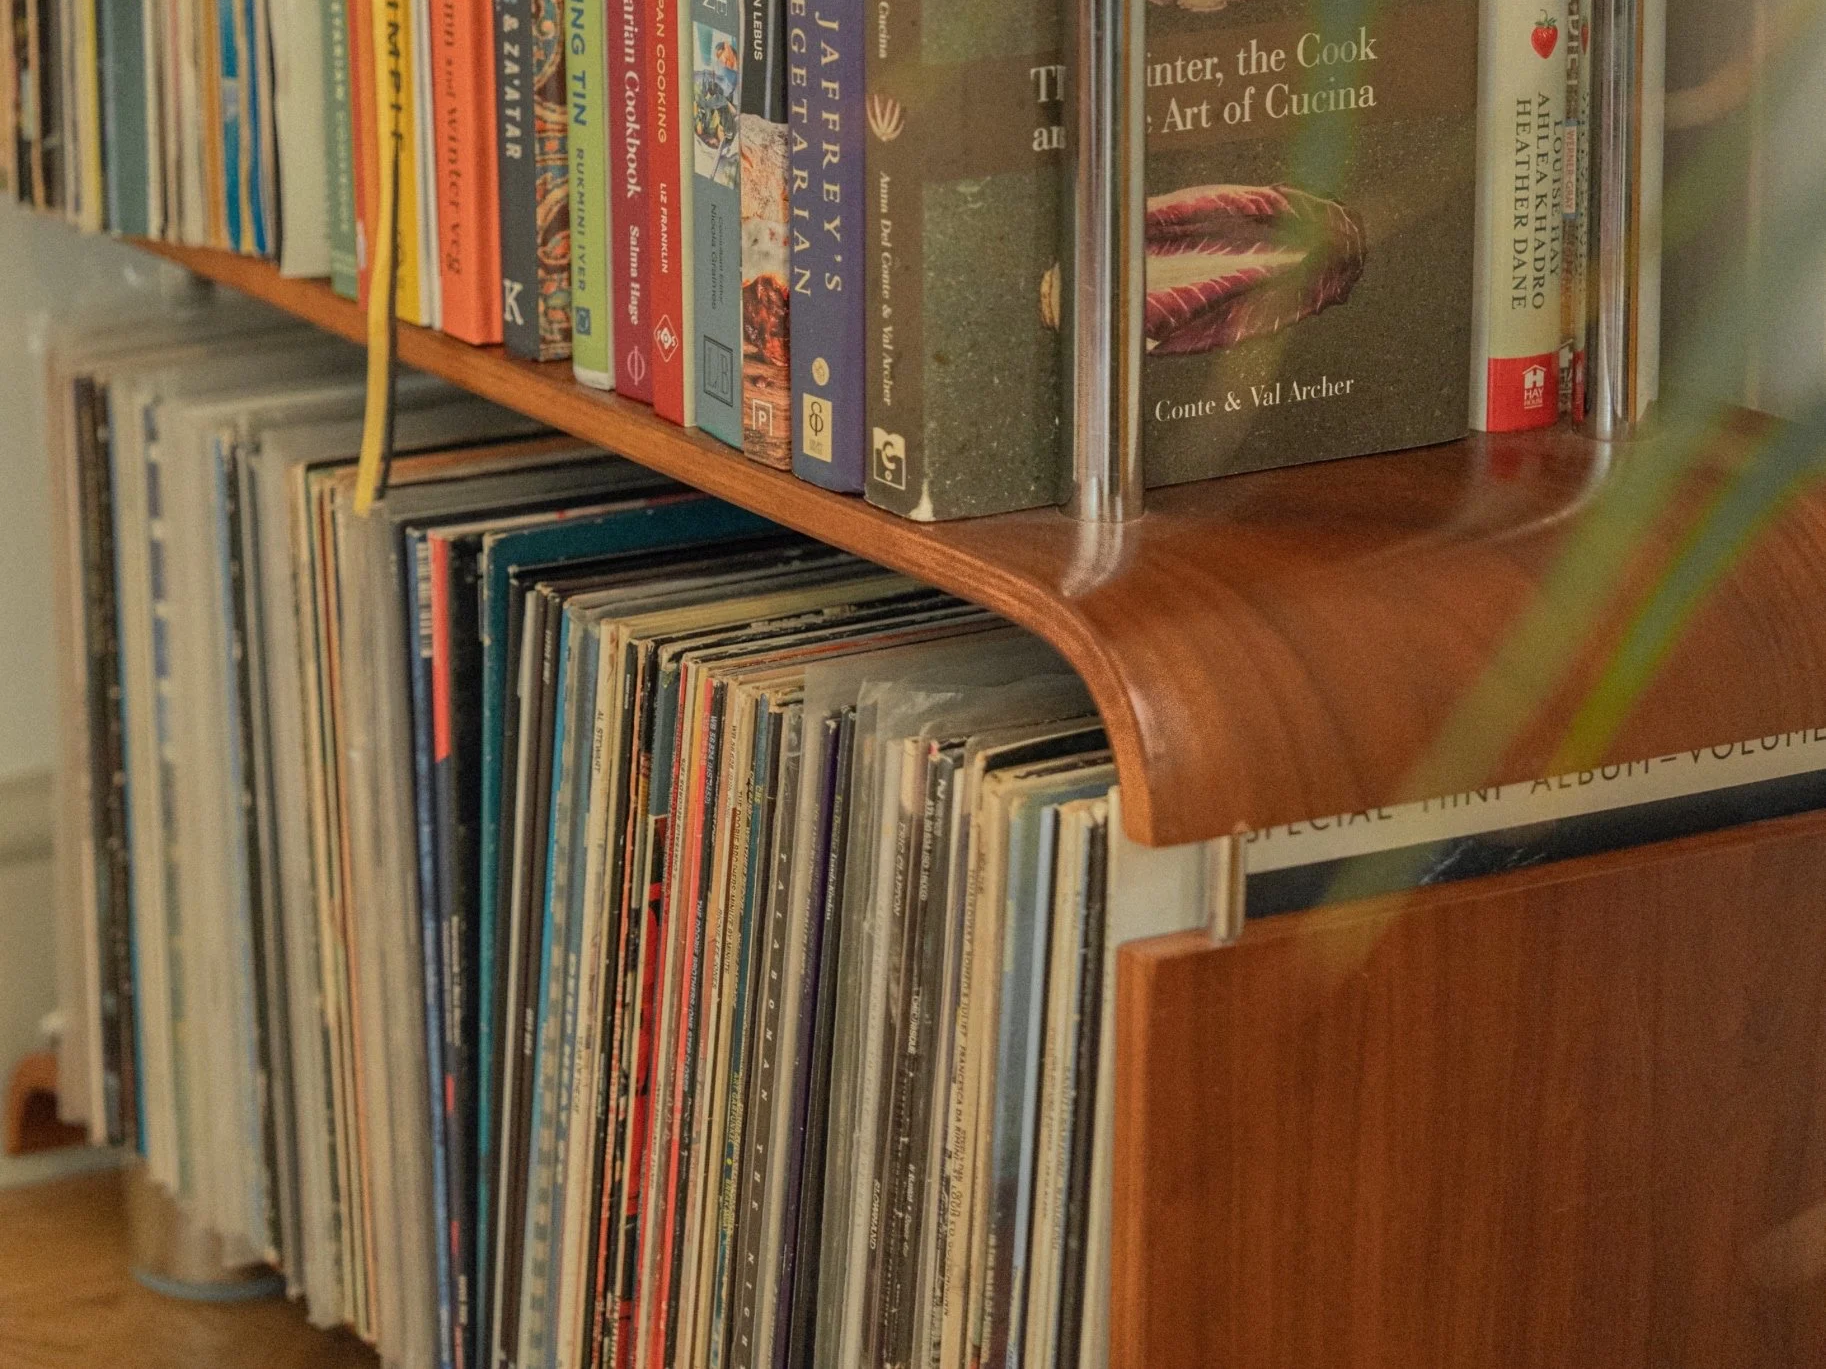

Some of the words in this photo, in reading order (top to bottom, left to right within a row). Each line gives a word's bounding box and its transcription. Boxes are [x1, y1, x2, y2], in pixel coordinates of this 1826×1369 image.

[502, 13, 520, 33] &
[753, 12, 764, 60] LEBUS
[878, 2, 890, 58] Cucina
[1147, 55, 1224, 87] inter,
[1237, 38, 1286, 76] the
[1296, 26, 1379, 67] Cook
[503, 41, 522, 160] ZA'ATAR
[572, 70, 588, 126] TIN
[656, 44, 668, 143] COOKING
[1162, 97, 1212, 133] Art
[1223, 86, 1255, 124] of
[1265, 81, 1377, 119] Cucina
[624, 70, 643, 198] Cookbook
[815, 11, 843, 292] JAFFREY'S
[1535, 92, 1551, 185] AHLEA
[1512, 99, 1532, 230] HEATHER
[1551, 120, 1563, 216] LOUISE
[576, 148, 587, 235] RUKMINI
[659, 183, 668, 203] LIZ
[880, 171, 892, 214] Anna
[445, 221, 463, 276] veg
[628, 225, 641, 276] Salma
[660, 207, 669, 274] FRANKLIN
[880, 218, 892, 247] Del
[1531, 193, 1548, 310] KHADRO
[1550, 224, 1561, 278] HAY
[577, 244, 587, 291] IYER
[881, 252, 893, 298] Conte
[1511, 238, 1529, 310] DANE
[503, 279, 524, 325] K
[627, 282, 642, 325] Hage
[882, 304, 893, 319] &
[882, 324, 894, 348] Val
[882, 352, 895, 407] Archer
[1154, 388, 1216, 422] Conte
[1224, 391, 1241, 412] &
[1249, 382, 1281, 408] Val
[1287, 374, 1355, 403] Archer
[759, 412, 768, 424] P
[594, 727, 604, 774] STEWART
[755, 784, 763, 804] CBS
[1531, 760, 1650, 794] ALBUM
[896, 822, 907, 853] ERIC
[696, 900, 704, 918] THE
[892, 854, 905, 917] CLAPTON
[694, 919, 703, 954] DOOBIE
[711, 959, 720, 990] JONES
[731, 1072, 739, 1090] ART
[728, 1093, 739, 1143] GARFUNKEL
[752, 1143, 764, 1212] THE
[869, 1178, 881, 1251] SLOWHAND
